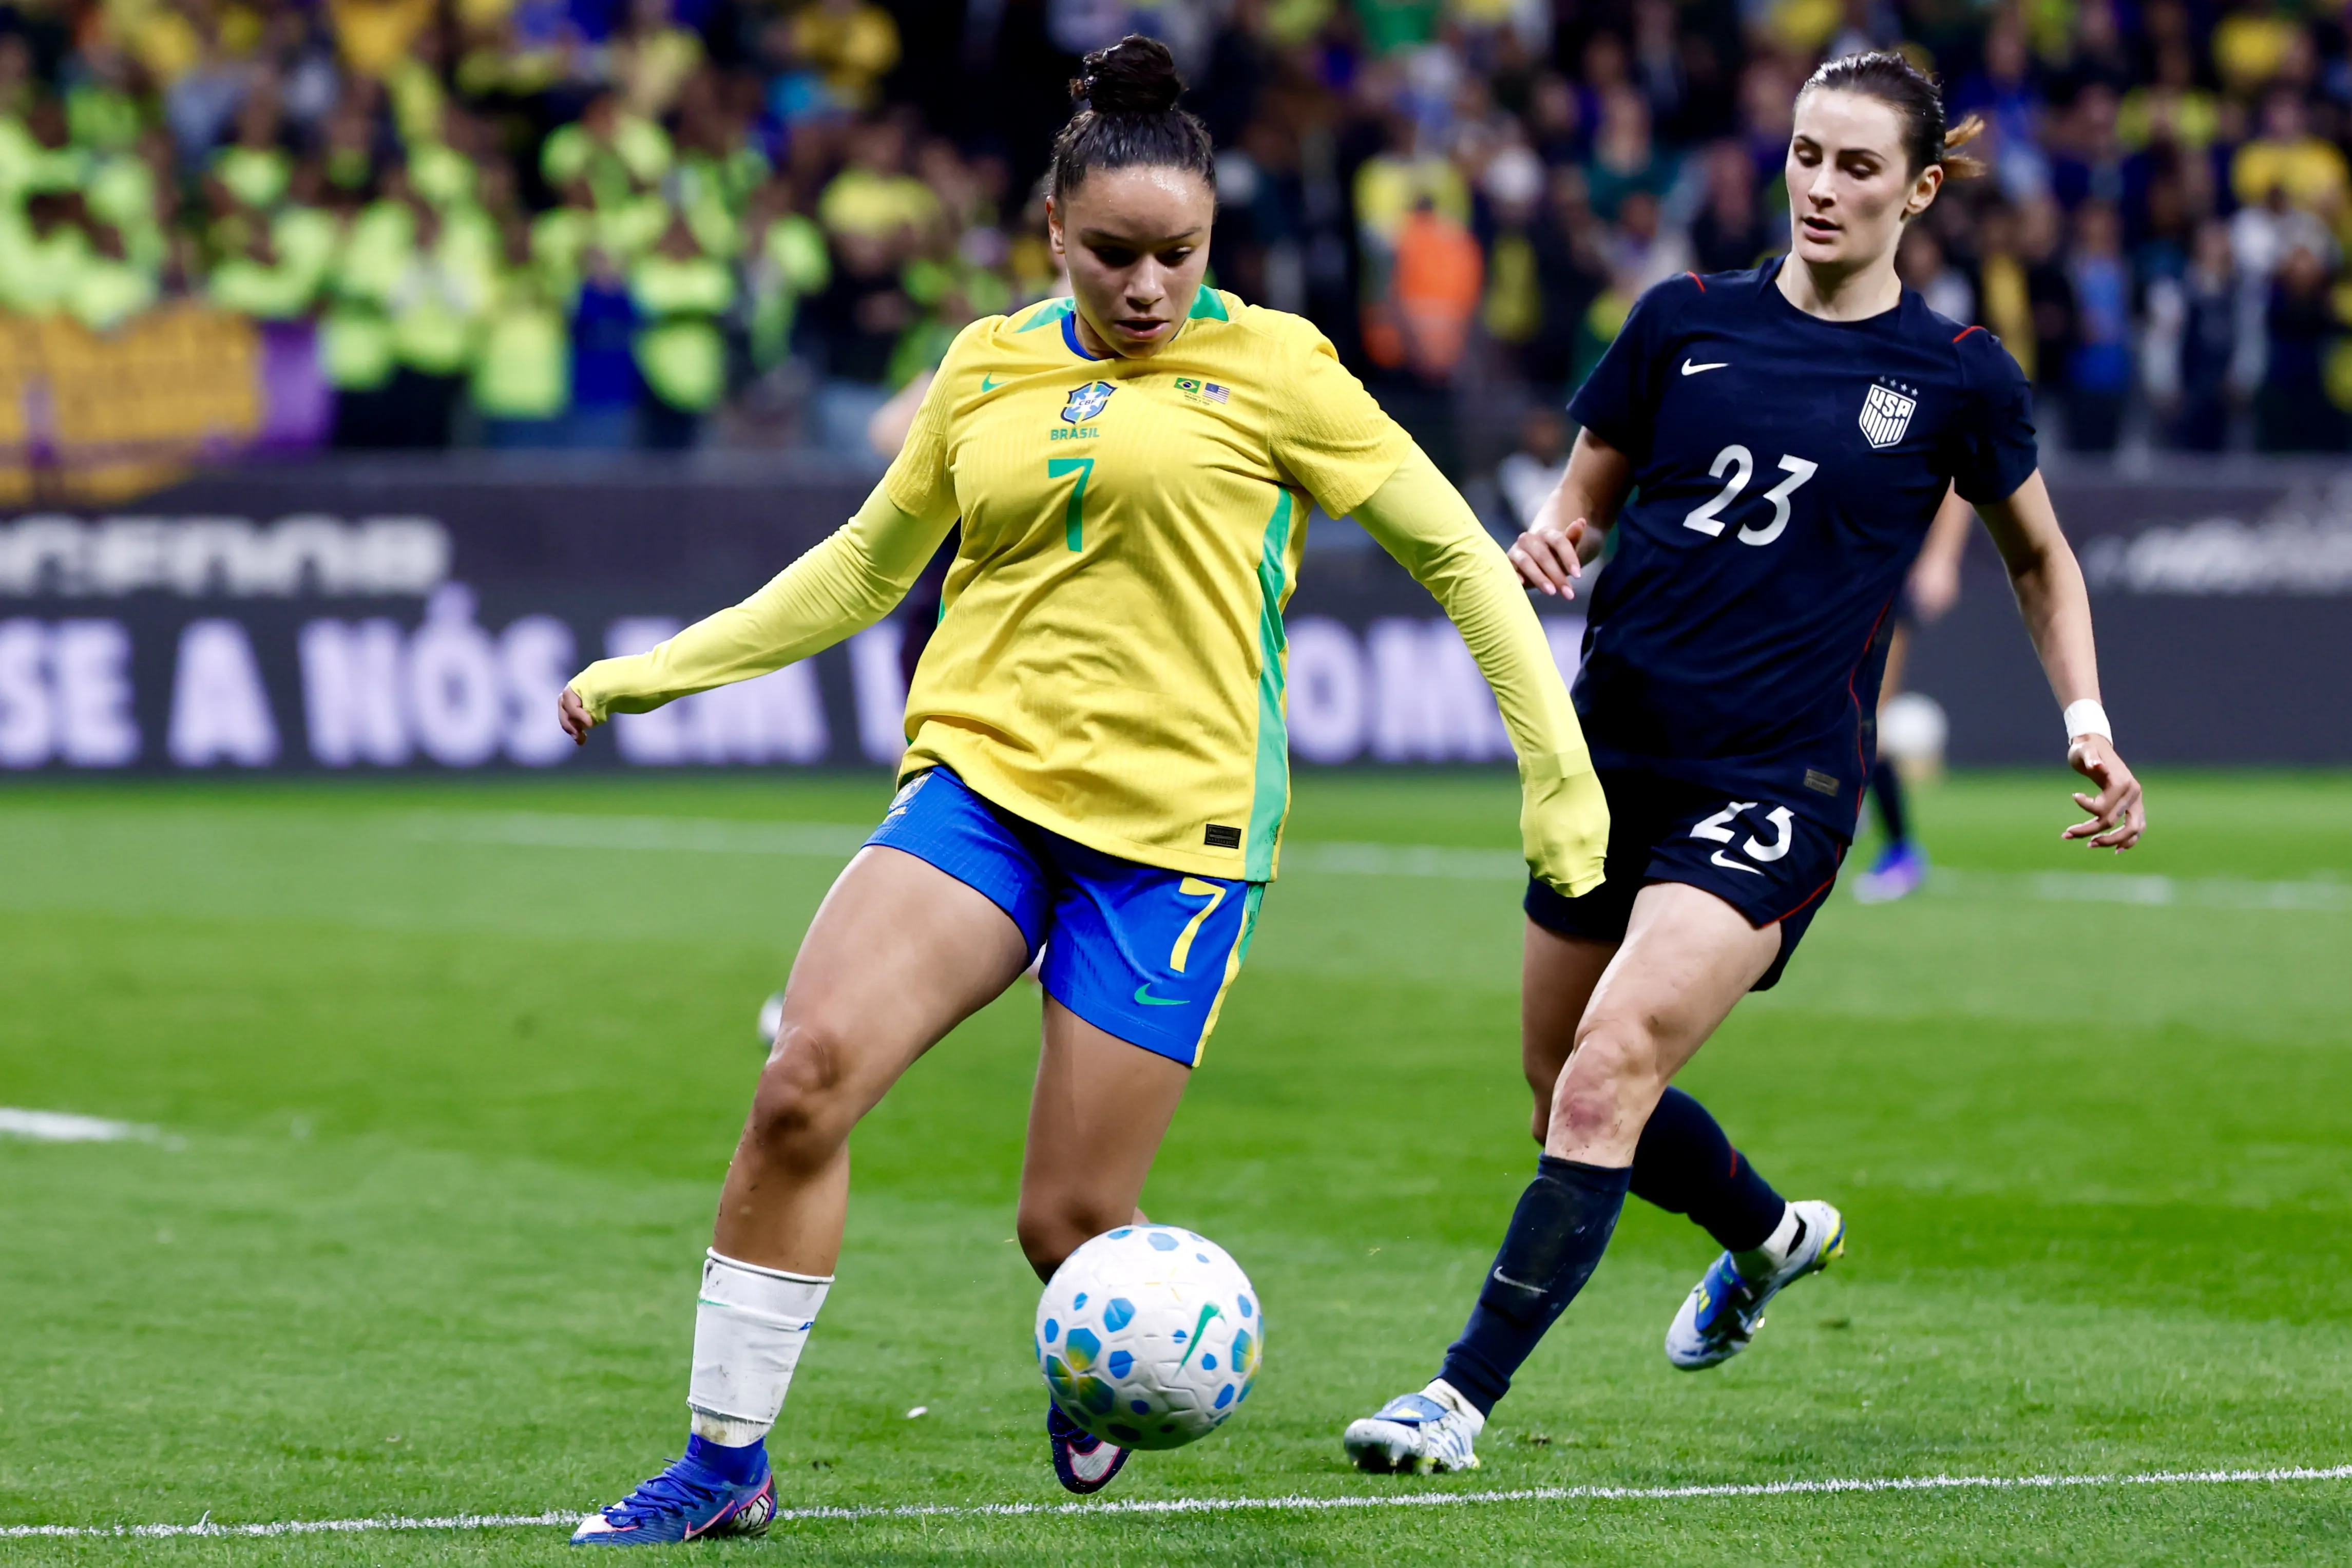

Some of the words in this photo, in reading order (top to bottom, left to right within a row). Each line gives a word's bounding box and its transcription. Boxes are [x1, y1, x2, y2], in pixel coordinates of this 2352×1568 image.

[1050, 427, 1100, 441] BRASIL
[1870, 389, 1911, 417] USA
[1048, 458, 1094, 552] 7
[1683, 444, 1819, 546] 23
[167, 618, 281, 768] A
[298, 581, 576, 768] NÓS
[1689, 801, 1795, 862] 23
[1170, 876, 1226, 973] 7
